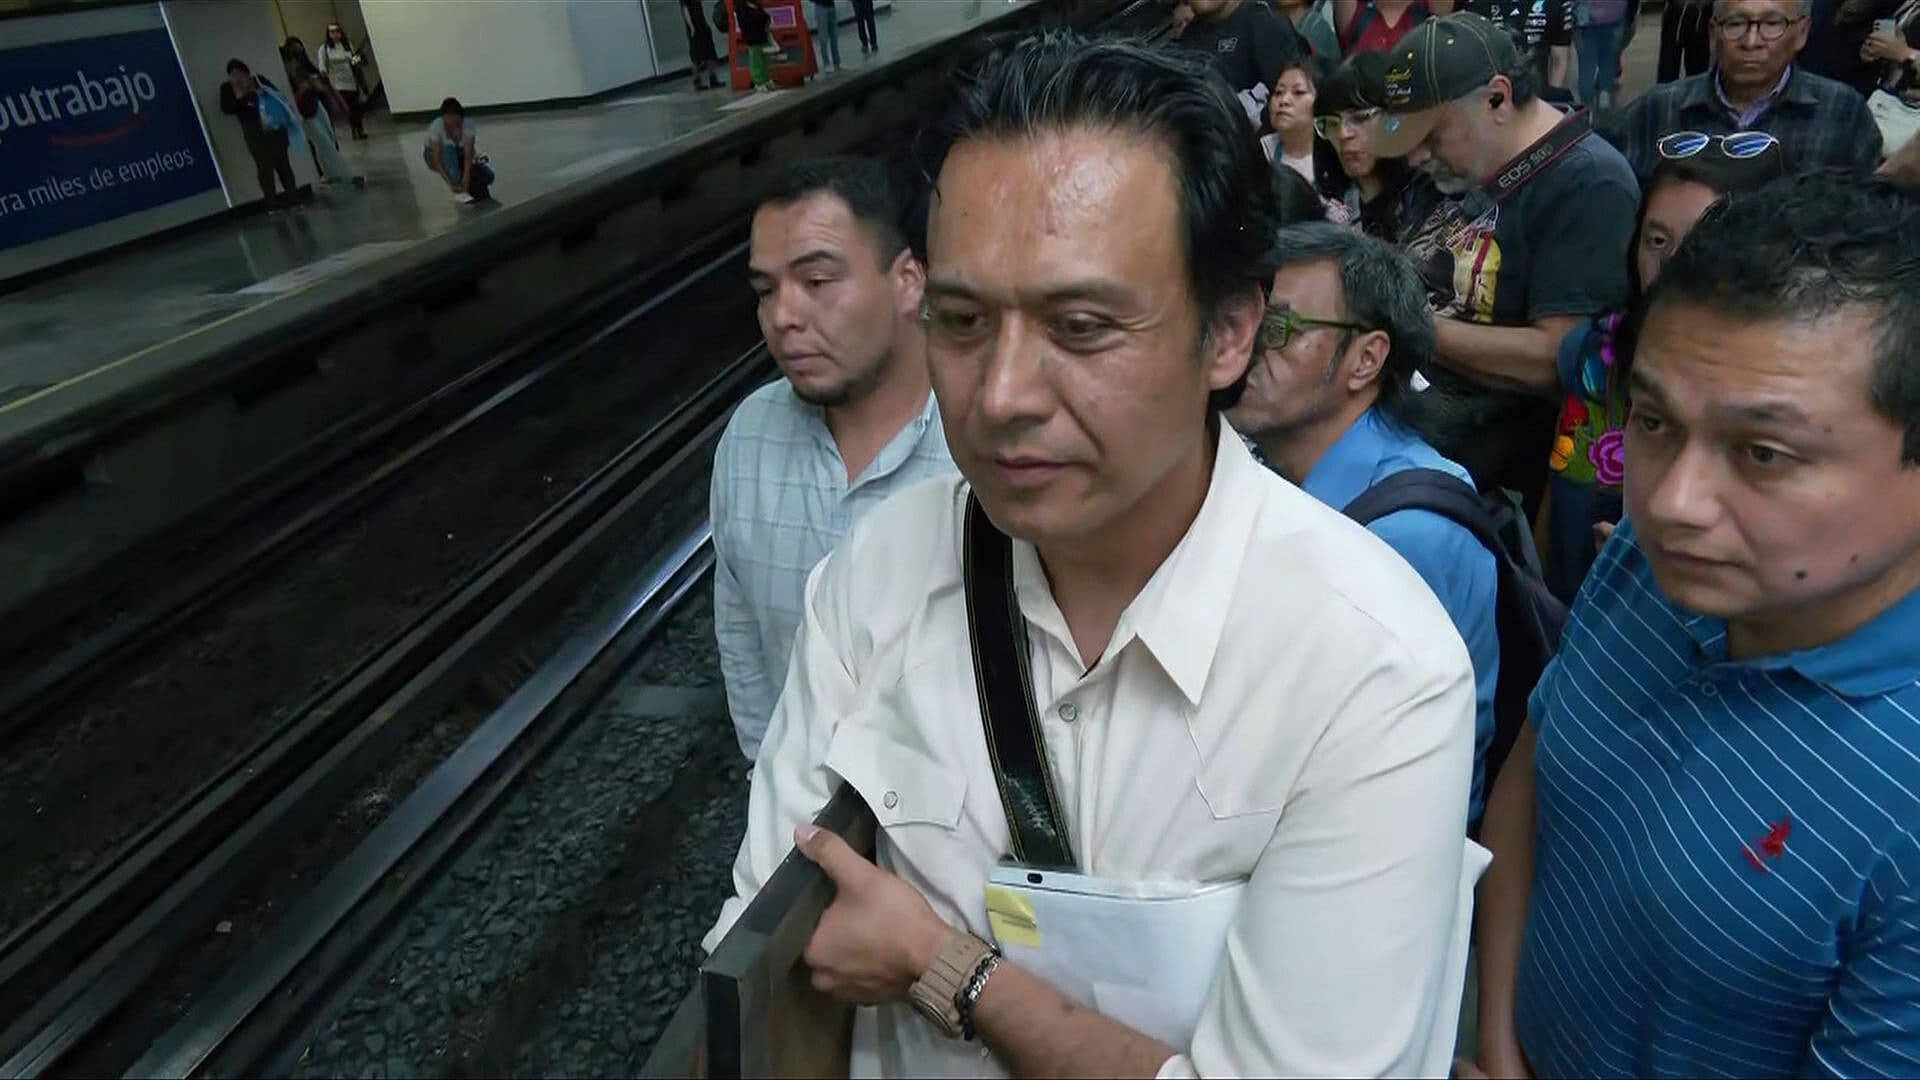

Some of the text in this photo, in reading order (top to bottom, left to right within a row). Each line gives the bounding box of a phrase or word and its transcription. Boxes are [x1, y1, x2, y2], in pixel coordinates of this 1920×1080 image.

[28, 177, 86, 206] miles
[89, 168, 115, 190] de
[118, 148, 194, 181] empleos
[1498, 160, 1531, 188] EOS
